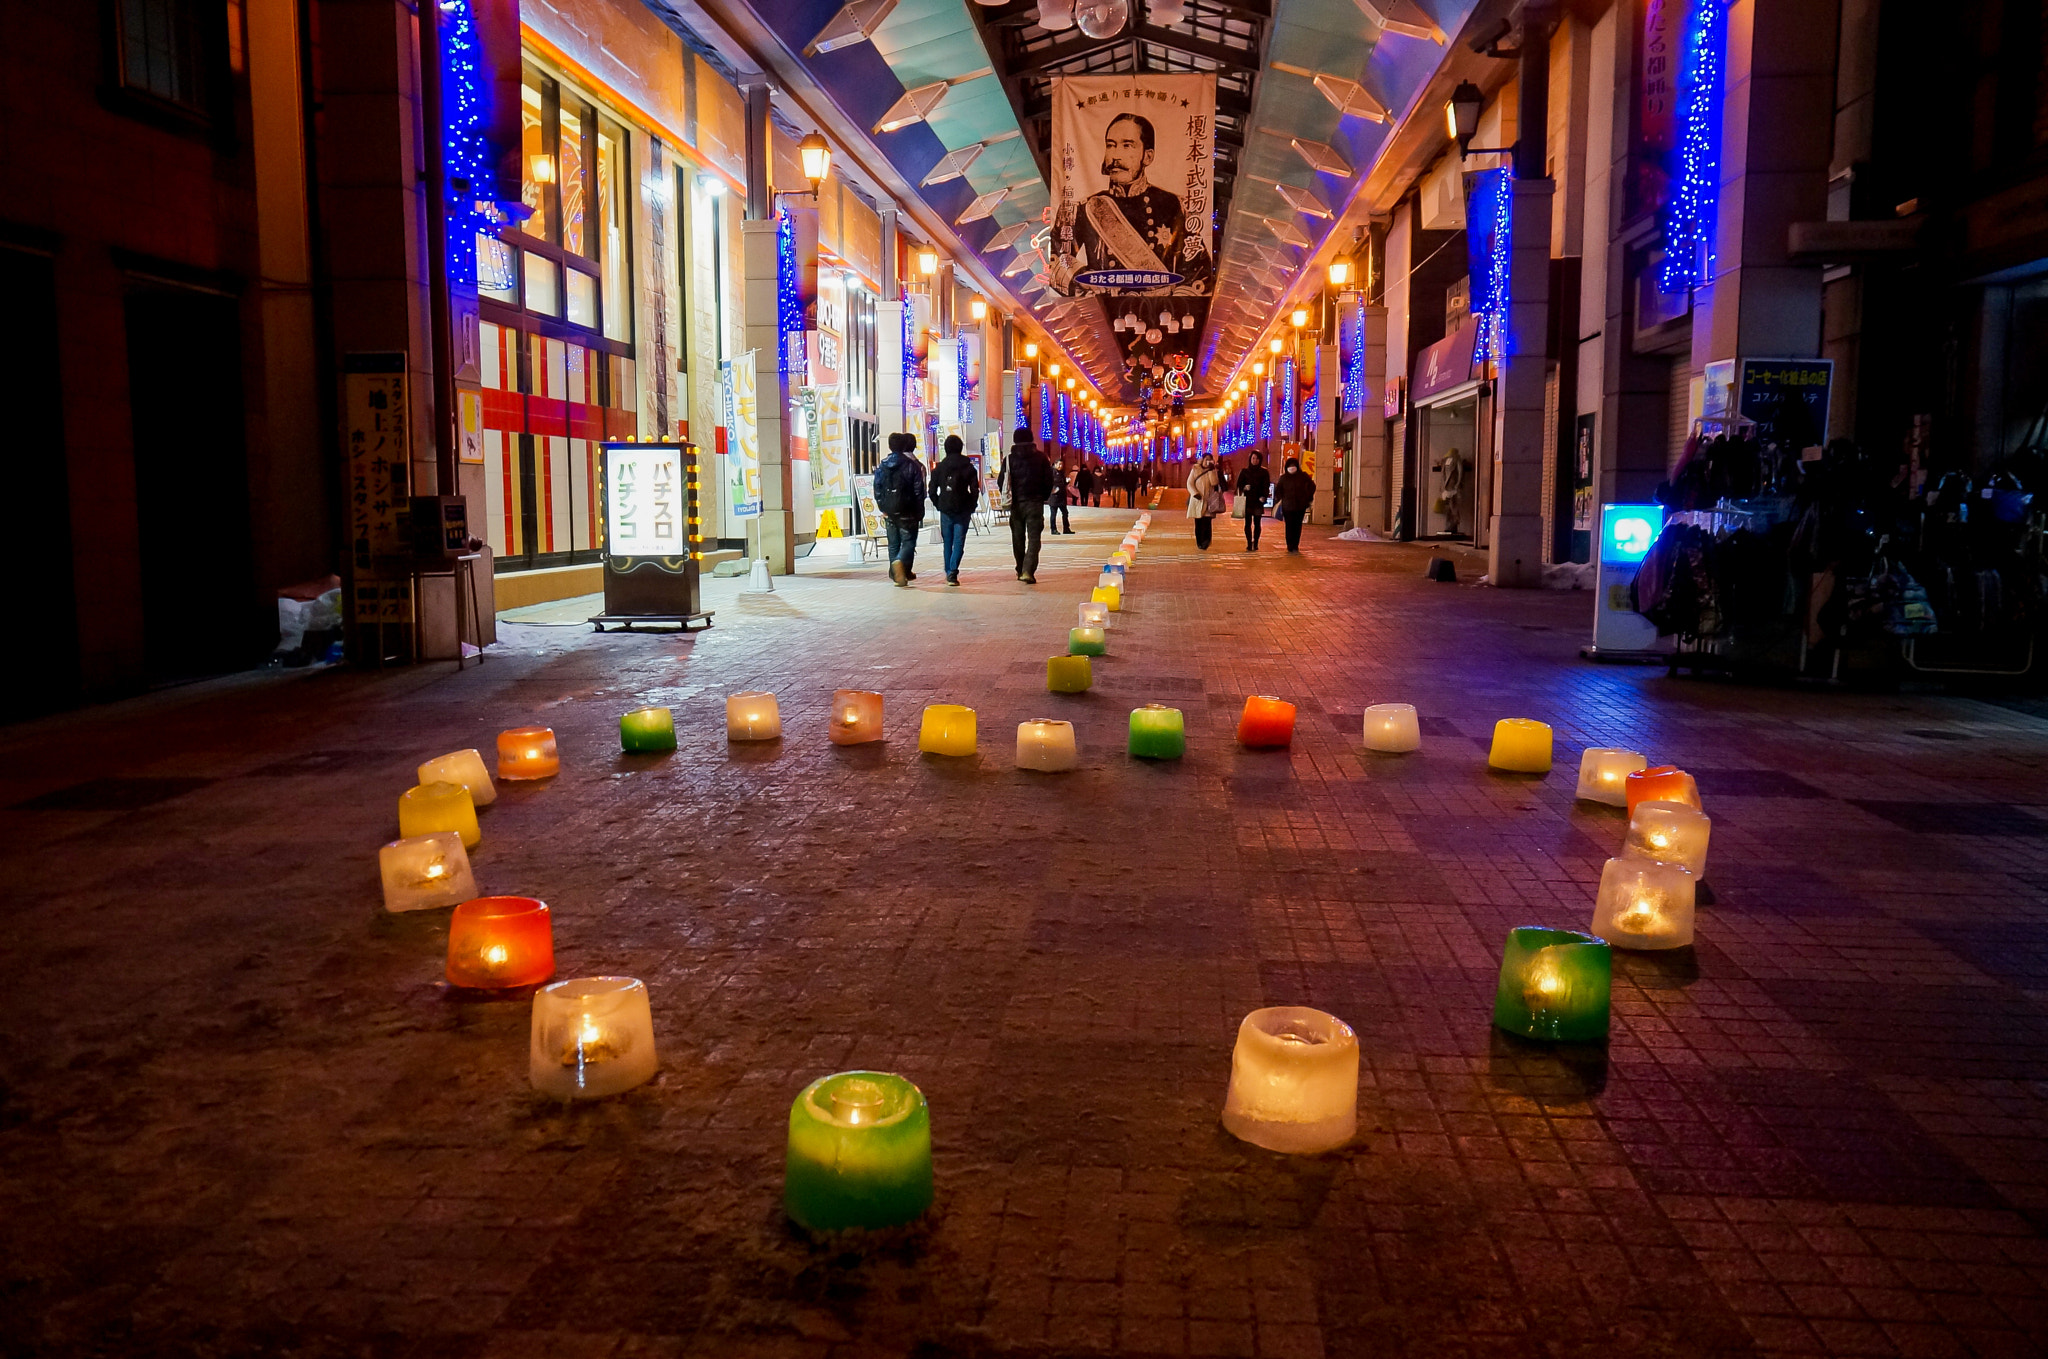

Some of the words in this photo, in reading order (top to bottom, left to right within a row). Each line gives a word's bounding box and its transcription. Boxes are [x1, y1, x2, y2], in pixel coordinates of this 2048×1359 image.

[1183, 115, 1207, 262] 榎本武揚の夢
[1089, 274, 1170, 284] おたる都通り商店街
[617, 461, 637, 539] パチンコ
[653, 461, 673, 539] パチスロ
